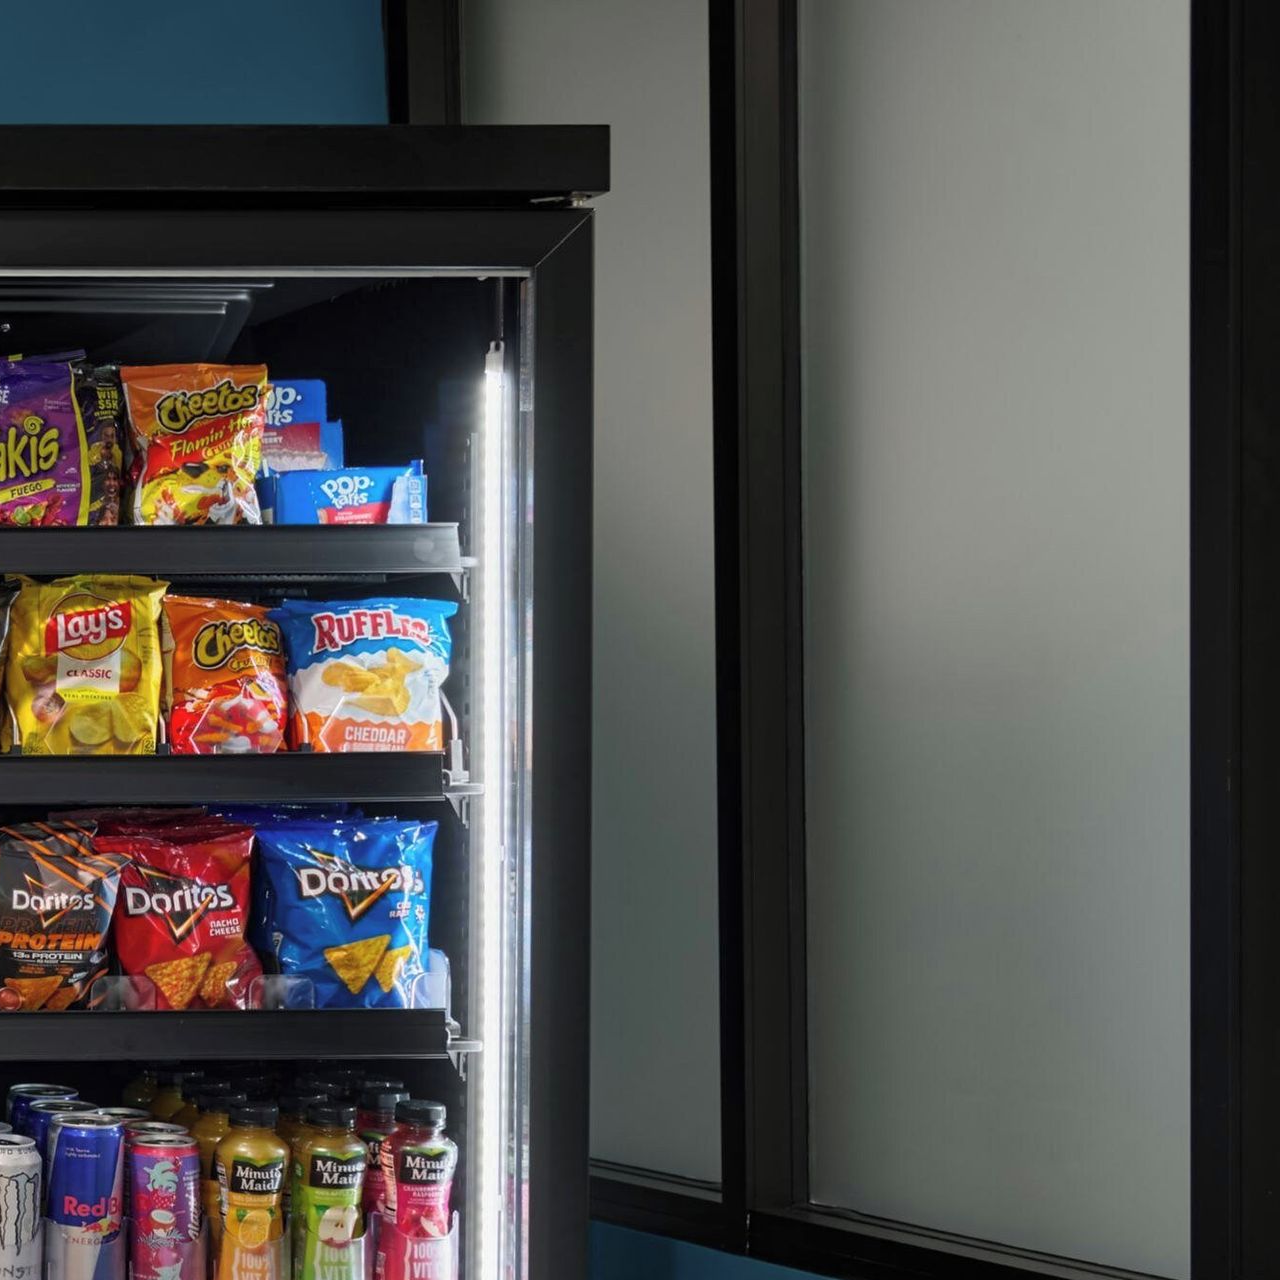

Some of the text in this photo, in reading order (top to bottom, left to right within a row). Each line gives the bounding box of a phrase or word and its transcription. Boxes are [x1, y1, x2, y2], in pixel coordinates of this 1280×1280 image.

[96, 387, 118, 401] WIN
[157, 379, 260, 434] Cheetos
[10, 482, 43, 499] FUEGO
[331, 489, 368, 508] tarts
[56, 607, 124, 649] Lay's
[312, 610, 432, 653] RUFFLES
[194, 618, 281, 670] Cheetos
[66, 669, 112, 679] CLASSIC
[344, 725, 406, 744] CHEDDAR
[298, 866, 424, 898] Doritos
[12, 890, 95, 911] Doritos
[125, 884, 234, 916] Doritos
[209, 918, 239, 928] NACHO
[241, 1178, 275, 1192] Maid
[64, 1196, 104, 1217] Red
